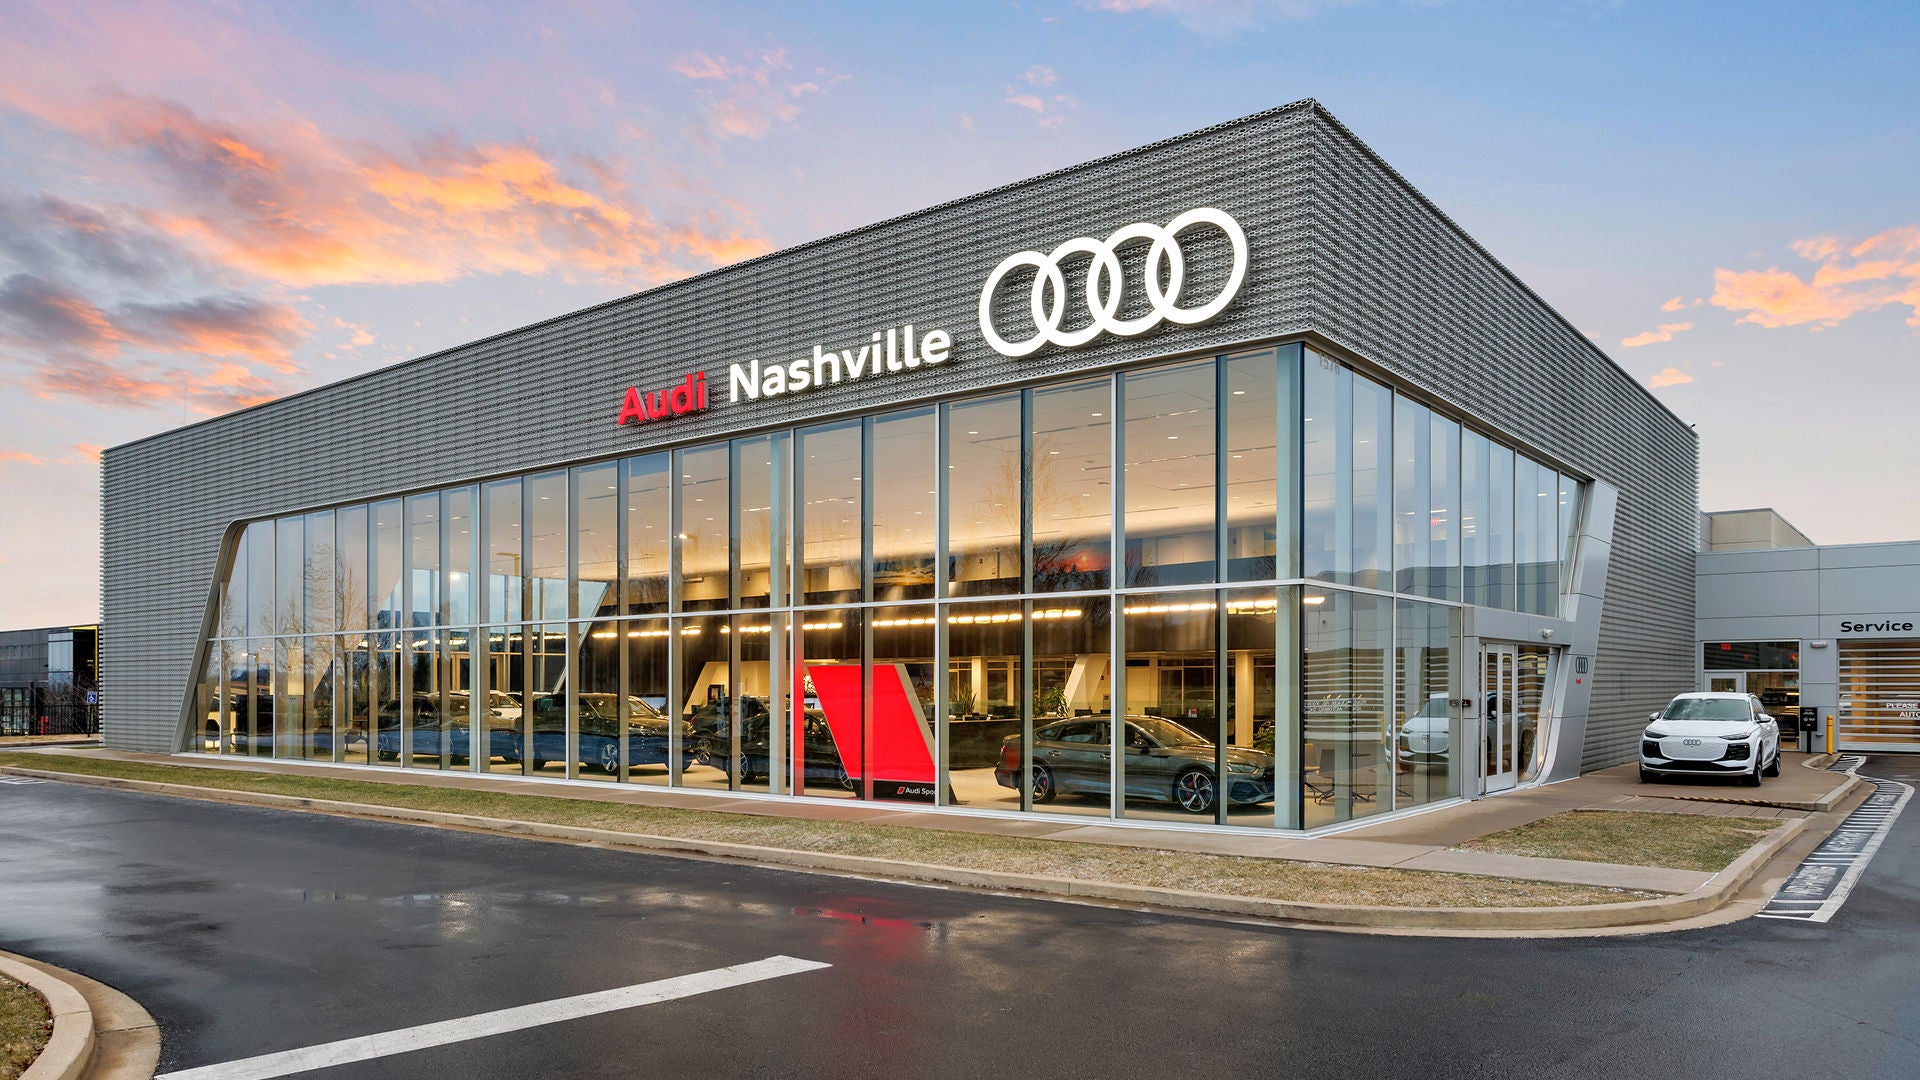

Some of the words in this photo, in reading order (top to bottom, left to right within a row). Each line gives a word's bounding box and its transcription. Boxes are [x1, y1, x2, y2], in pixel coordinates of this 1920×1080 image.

[617, 371, 706, 425] Audi
[729, 324, 951, 402] Nashville
[1840, 620, 1914, 632] Service
